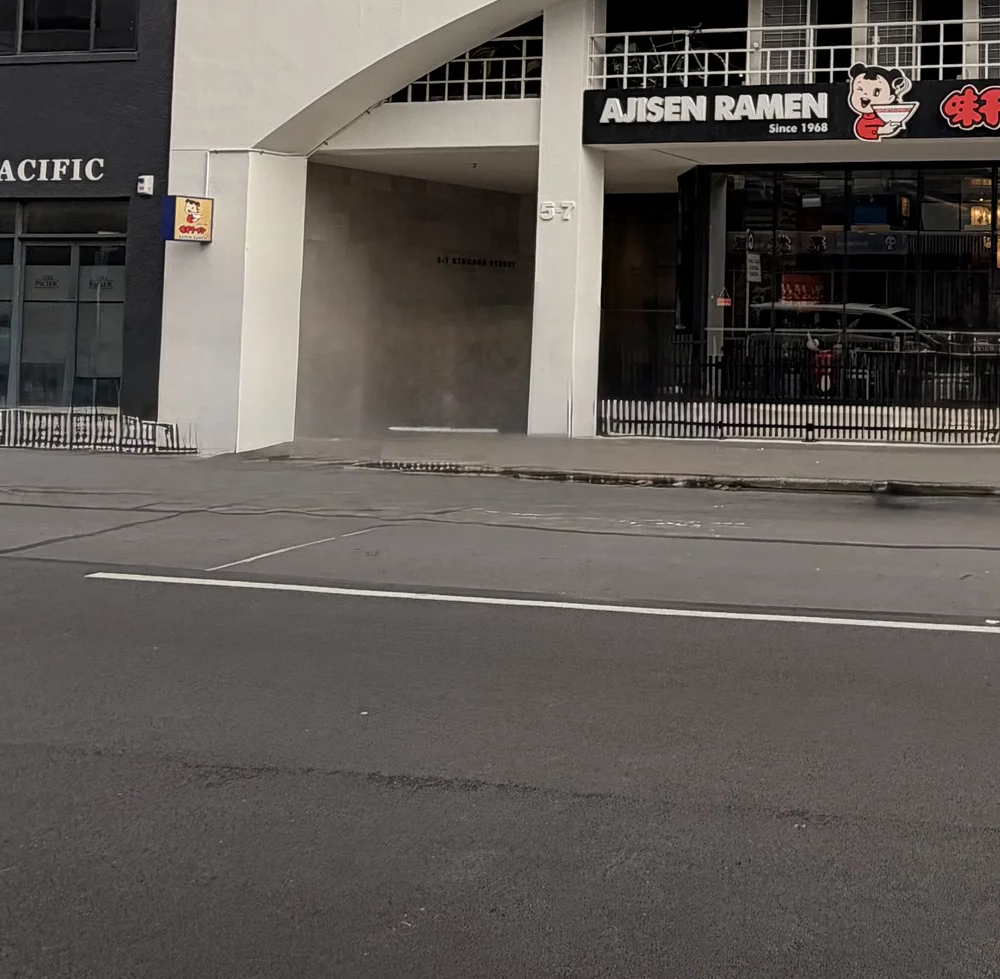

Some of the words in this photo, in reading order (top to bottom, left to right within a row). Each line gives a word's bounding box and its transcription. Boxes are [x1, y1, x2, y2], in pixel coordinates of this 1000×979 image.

[599, 95, 707, 123] AJISEN
[714, 92, 828, 121] RAMEN
[769, 124, 798, 134] Since
[801, 123, 829, 133] 1968
[540, 201, 576, 221] 5-7
